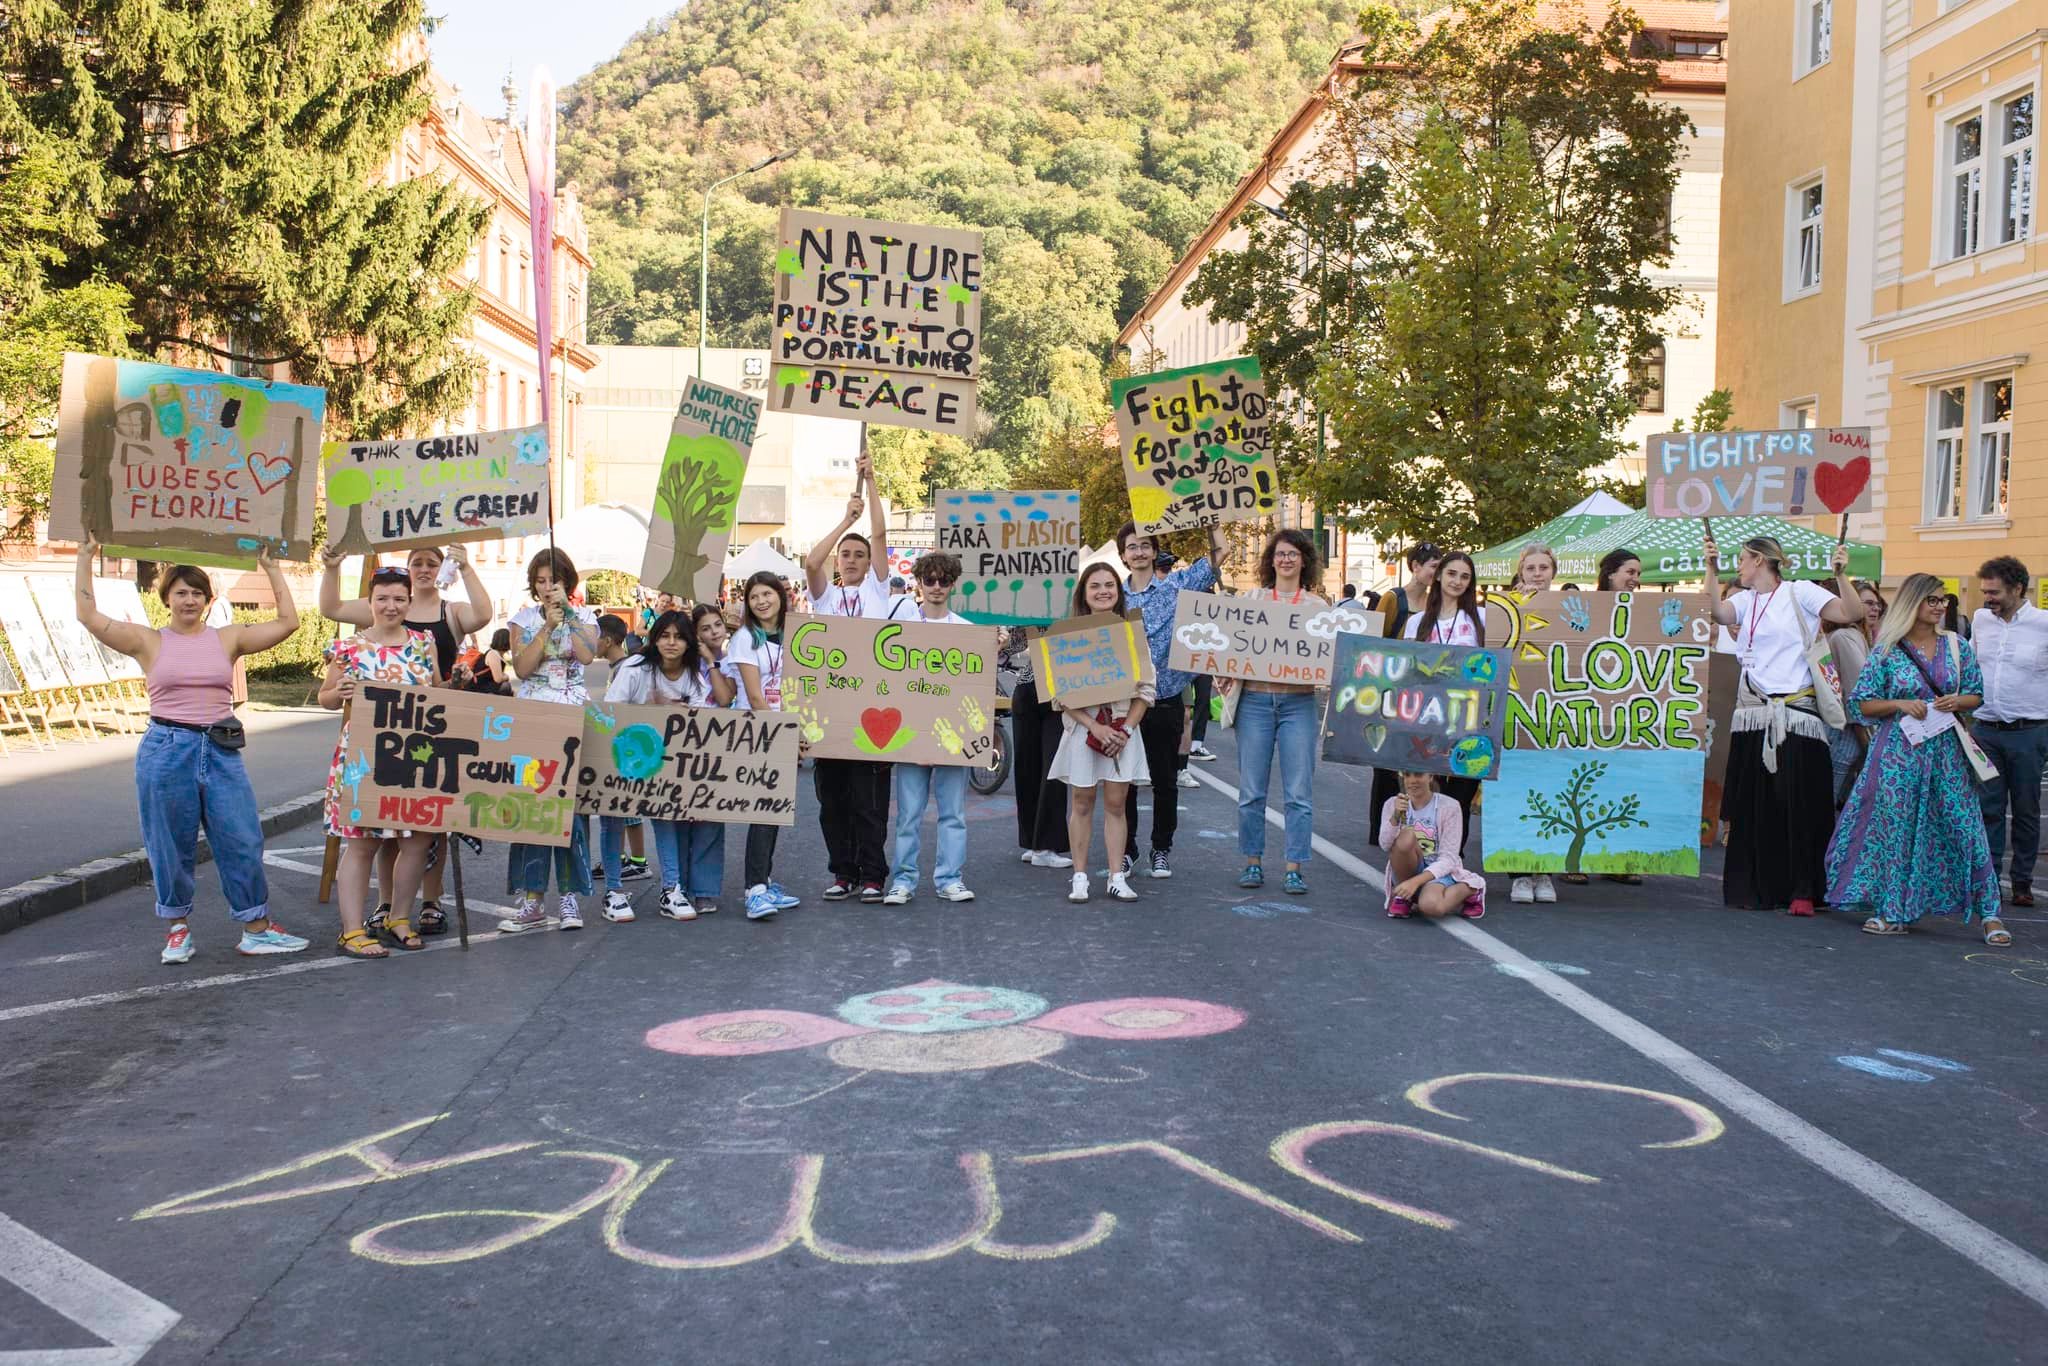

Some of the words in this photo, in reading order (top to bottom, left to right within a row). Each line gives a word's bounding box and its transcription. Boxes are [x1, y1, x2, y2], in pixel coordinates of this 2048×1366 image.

[799, 228, 981, 292] NATURE
[776, 303, 898, 341] PUREST
[908, 323, 975, 352] TO
[783, 335, 890, 364] PORTAL
[690, 383, 742, 413] NATURE
[810, 370, 960, 424] PEACE
[1126, 375, 1244, 432] Fight
[680, 402, 711, 423] OUR
[709, 410, 758, 447] HOME
[1134, 437, 1181, 465] for
[1764, 432, 1814, 457] FOR
[126, 464, 241, 491] IUBESC
[420, 456, 508, 487] GREEN
[1152, 450, 1211, 486] Not
[1208, 457, 1248, 485] for
[1653, 465, 1807, 517] LOVE!
[382, 501, 442, 538] LIVE
[454, 492, 539, 523] GREEN
[1194, 600, 1269, 626] LUMEA
[1289, 613, 1301, 631] E
[790, 622, 847, 670] Go
[873, 624, 984, 676] Green
[1233, 630, 1331, 658] SUMBR
[1268, 662, 1327, 681] UMBR
[1355, 652, 1406, 681] NU
[1551, 641, 1705, 694] LOVE
[799, 675, 819, 696] To
[876, 680, 890, 695] it
[907, 677, 951, 696] clean
[1502, 692, 1702, 749] NATURE
[962, 736, 990, 760] LEO
[736, 760, 779, 790] este
[378, 796, 454, 827] MUST
